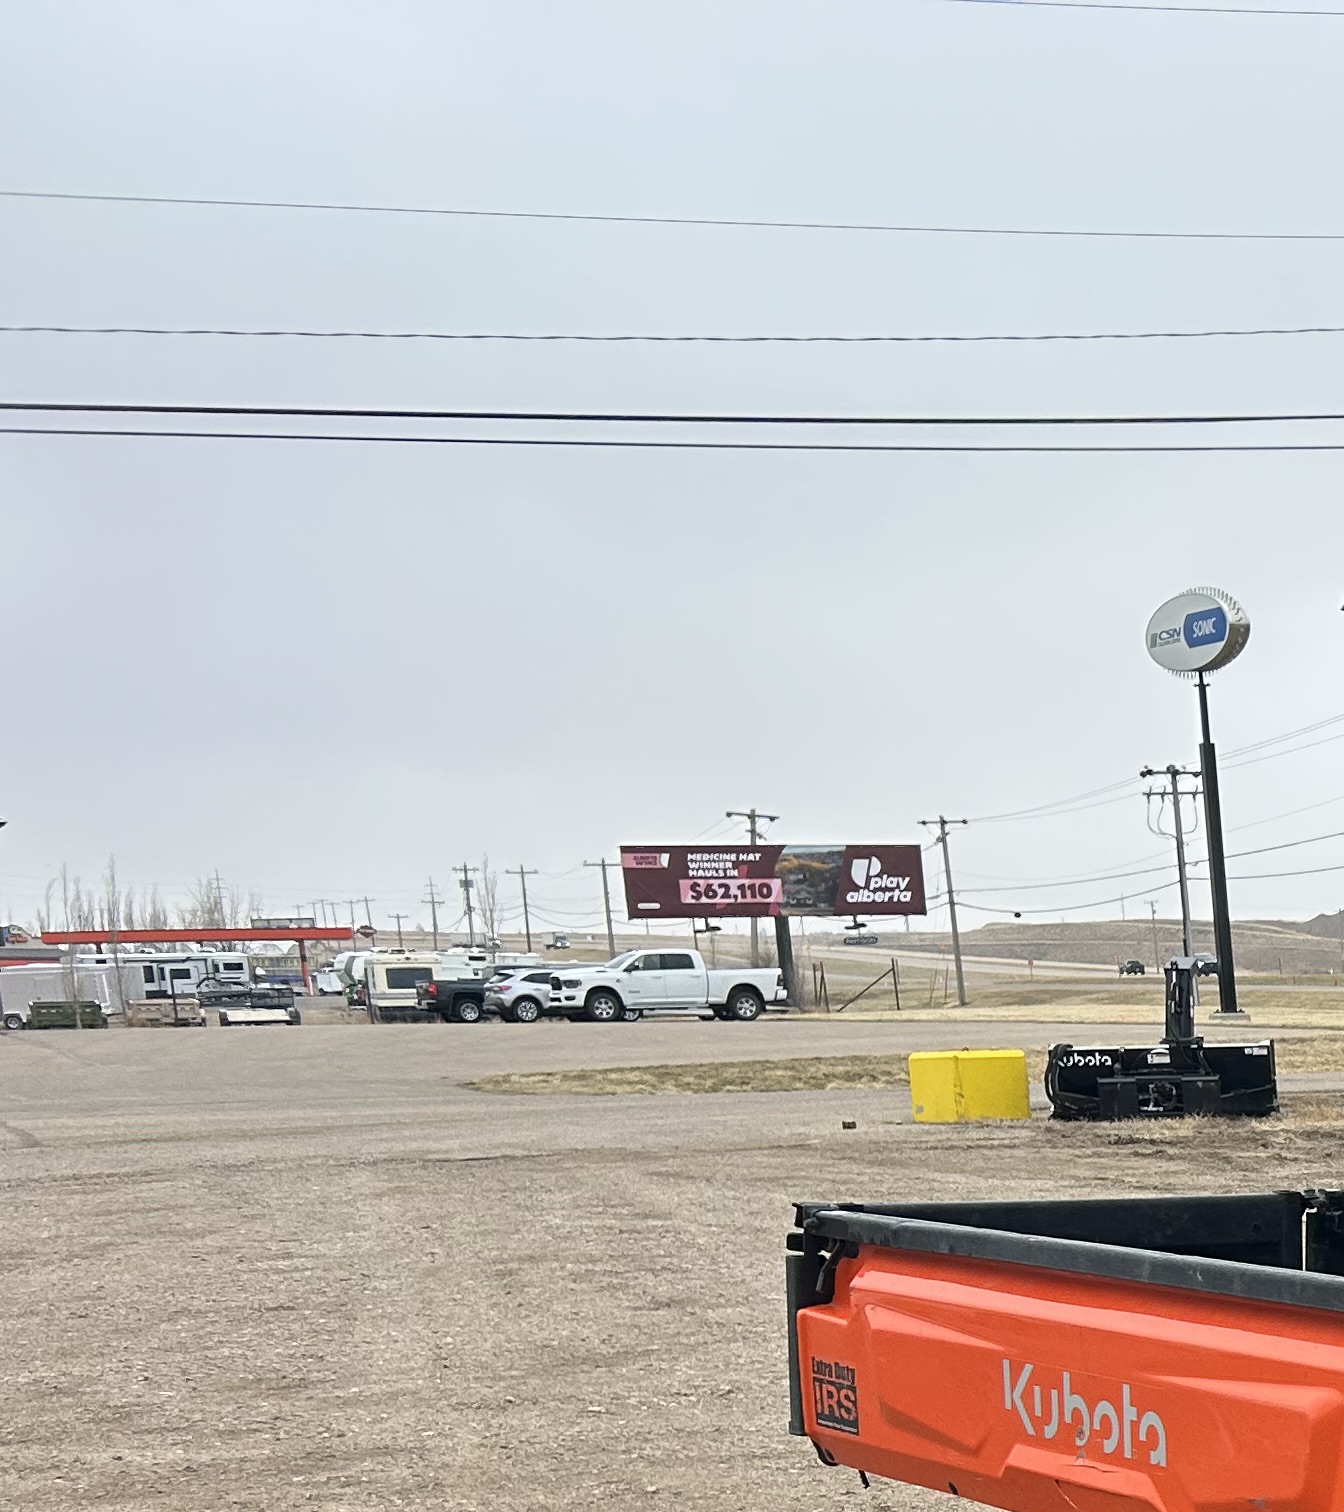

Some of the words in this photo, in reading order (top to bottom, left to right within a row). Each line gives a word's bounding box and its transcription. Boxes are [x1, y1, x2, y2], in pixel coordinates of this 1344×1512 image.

[1159, 627, 1182, 641] CSN
[1192, 617, 1217, 638] SONIC
[687, 852, 737, 861] MEDICINE
[739, 852, 762, 861] HAT
[688, 861, 733, 869] WINNER
[688, 869, 725, 877] HAULS
[726, 869, 739, 877] IN
[869, 874, 910, 890] play
[690, 881, 773, 902] $62,110
[846, 889, 912, 903] alberta
[812, 1356, 833, 1378] Extra
[834, 1362, 856, 1385] Duty
[815, 1382, 857, 1420] IRS
[1002, 1358, 1167, 1467] Kubota
